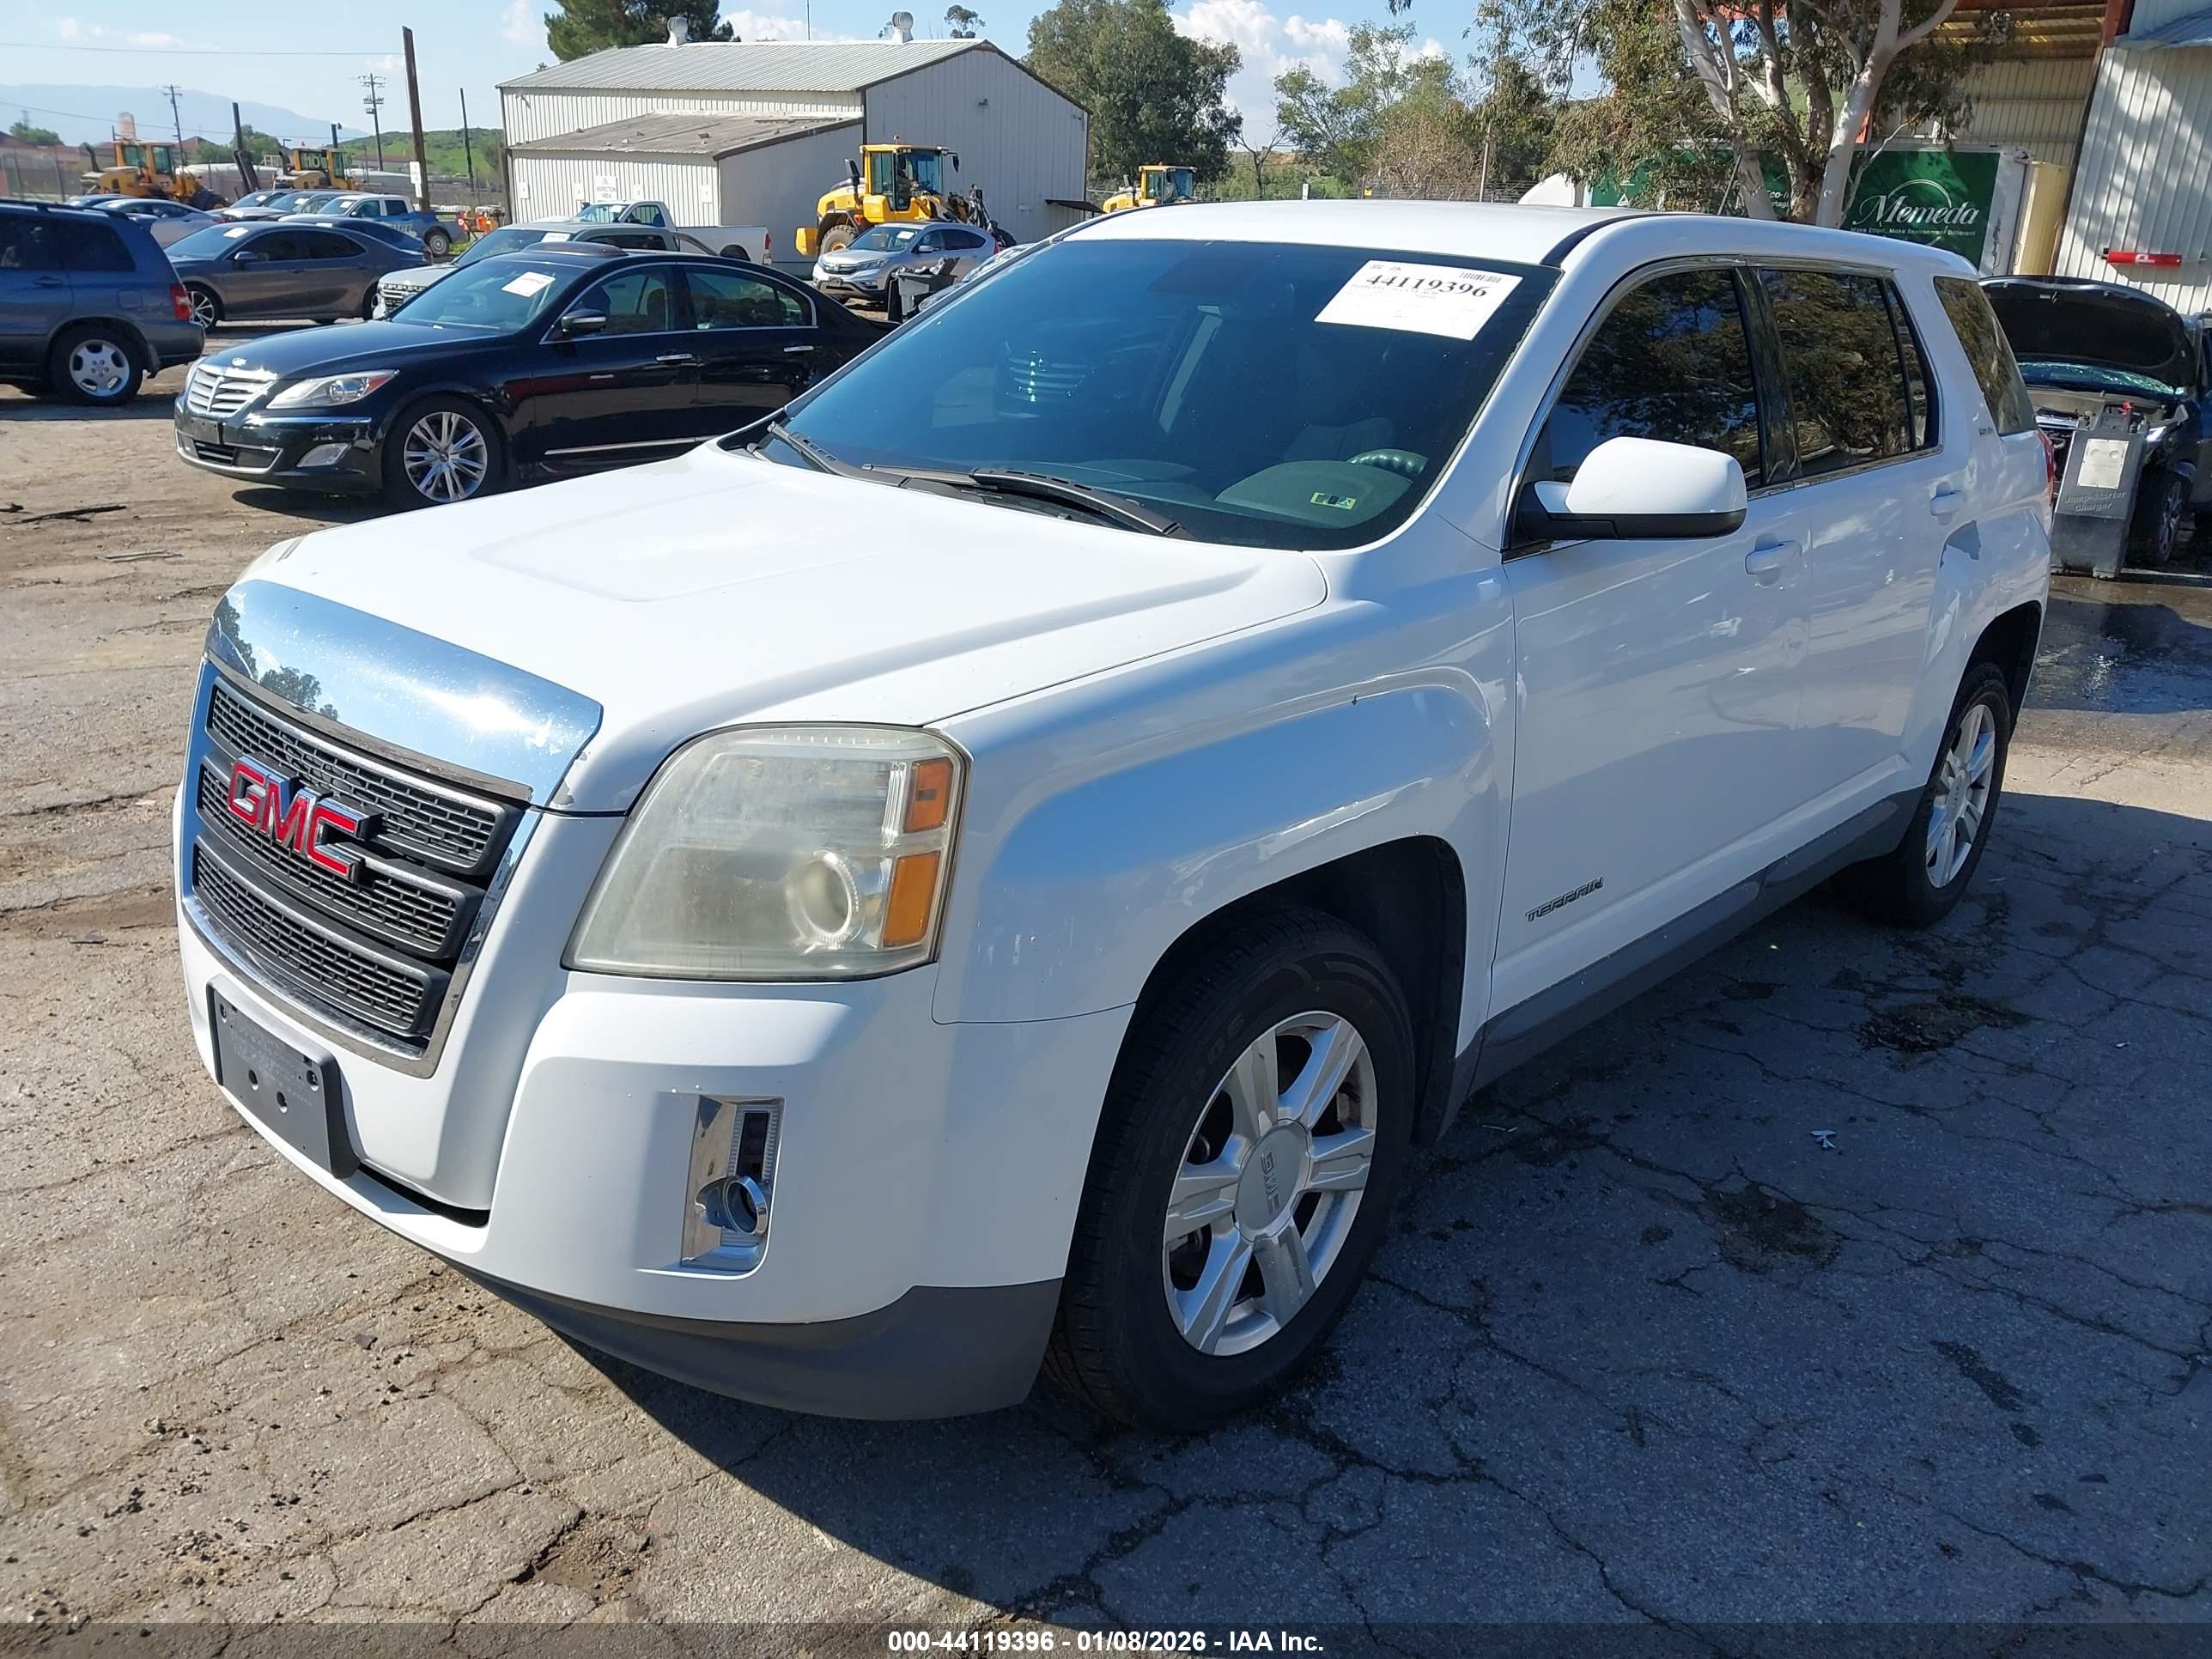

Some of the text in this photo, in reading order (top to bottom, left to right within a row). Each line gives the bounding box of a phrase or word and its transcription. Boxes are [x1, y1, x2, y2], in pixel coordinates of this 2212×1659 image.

[1851, 195, 1979, 225] Memeda
[1366, 274, 1492, 298] 44119396
[2075, 502, 2112, 513] Charger
[227, 756, 374, 882] GMC
[1525, 876, 1604, 922] TERRAIN
[1261, 1150, 1280, 1217] GMC
